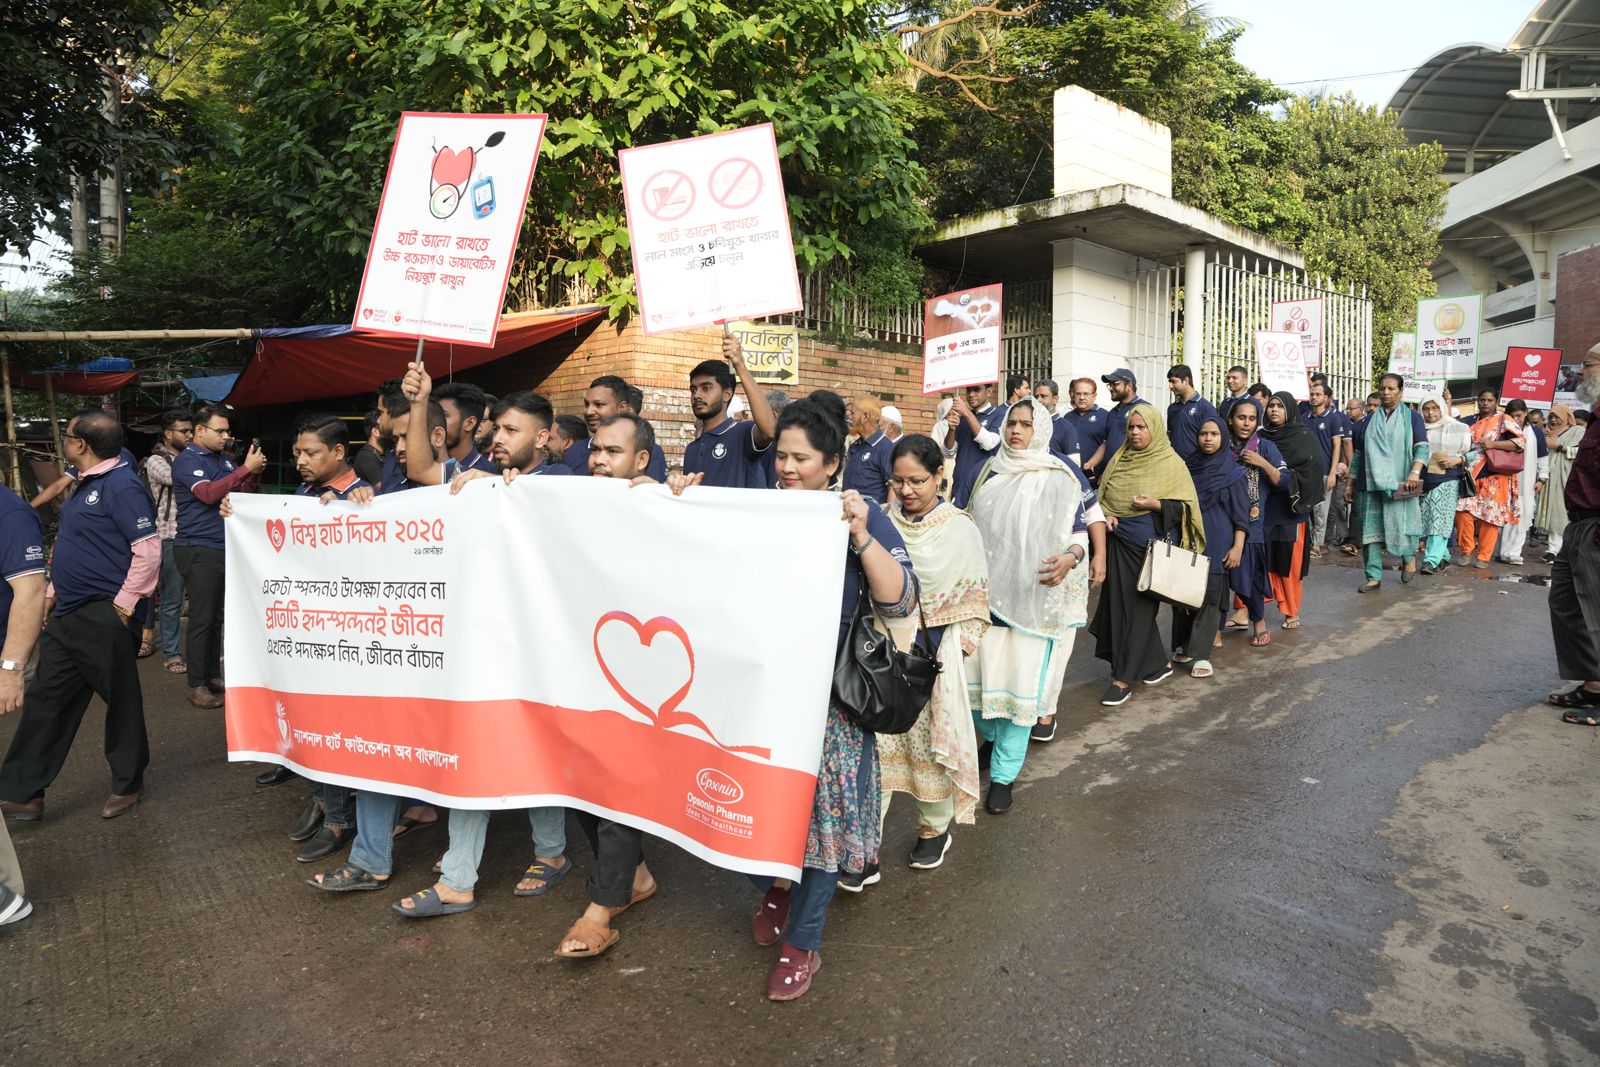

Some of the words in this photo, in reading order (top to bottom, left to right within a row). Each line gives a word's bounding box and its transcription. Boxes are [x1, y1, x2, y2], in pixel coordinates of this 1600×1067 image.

[397, 229, 418, 246] হার্ট
[421, 234, 452, 248] ভালো
[455, 236, 490, 252] রাখতে
[684, 223, 718, 239] ভালো
[721, 216, 759, 232] রাখতে
[383, 248, 400, 261] উচ্চ
[440, 273, 465, 290] রাখুন
[290, 517, 316, 549] বিশ্ব
[318, 514, 344, 545] হার্ট
[346, 514, 387, 544] দিবস
[395, 518, 445, 543] ২০২৫
[294, 579, 338, 598] স্পন্দনও
[341, 576, 380, 599] উপেক্ষা
[383, 581, 427, 600] করবেন
[430, 581, 446, 600] না
[265, 599, 300, 631] প্রতিটি
[391, 604, 444, 637] জীবন
[266, 636, 293, 658] এখনই
[295, 641, 336, 662] পদক্ষেপ
[338, 639, 363, 666] নিন,
[366, 641, 403, 667] জীবন
[405, 643, 444, 670] বাঁচান
[325, 731, 342, 751] হার্ট
[393, 744, 412, 761] অব
[415, 747, 459, 770] বাংলাদেশ
[687, 792, 715, 814] Opsonin
[716, 805, 753, 824] Pharma
